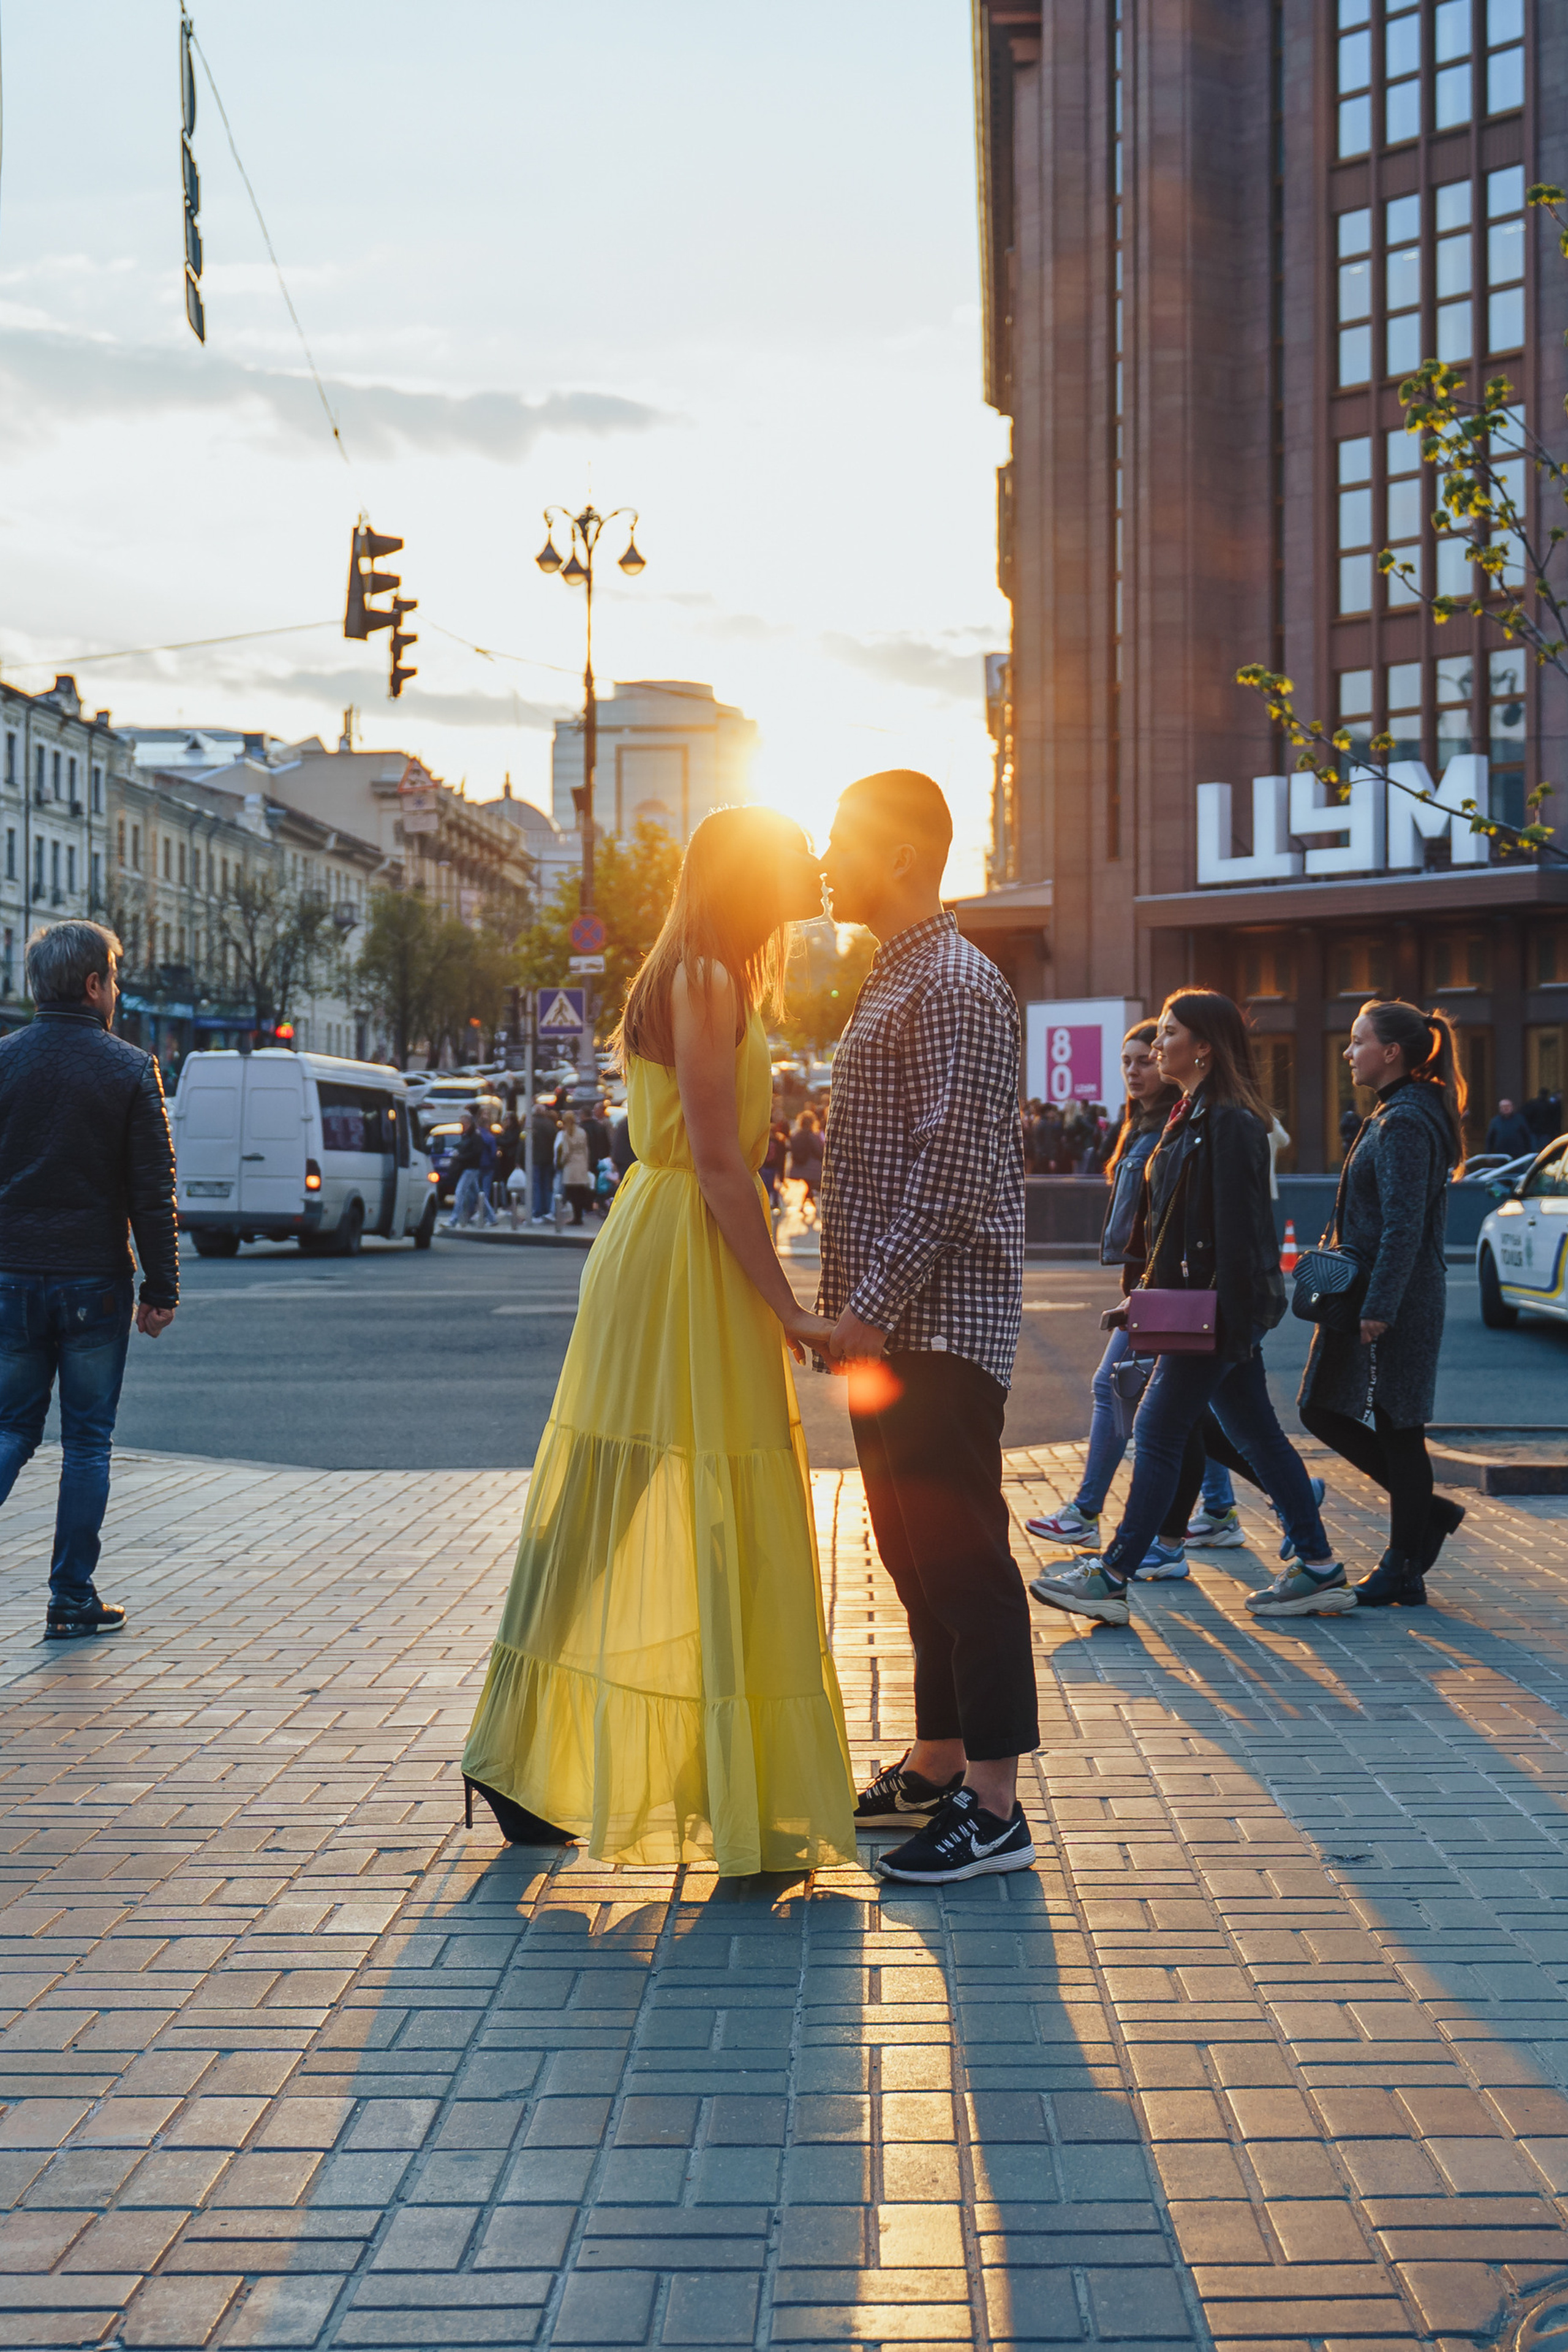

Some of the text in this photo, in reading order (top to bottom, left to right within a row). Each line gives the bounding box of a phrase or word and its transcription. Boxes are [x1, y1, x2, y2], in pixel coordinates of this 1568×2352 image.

[1197, 753, 1489, 884] ЦУМ
[1051, 1028, 1072, 1100] 80
[957, 1790, 973, 1803] NIKE
